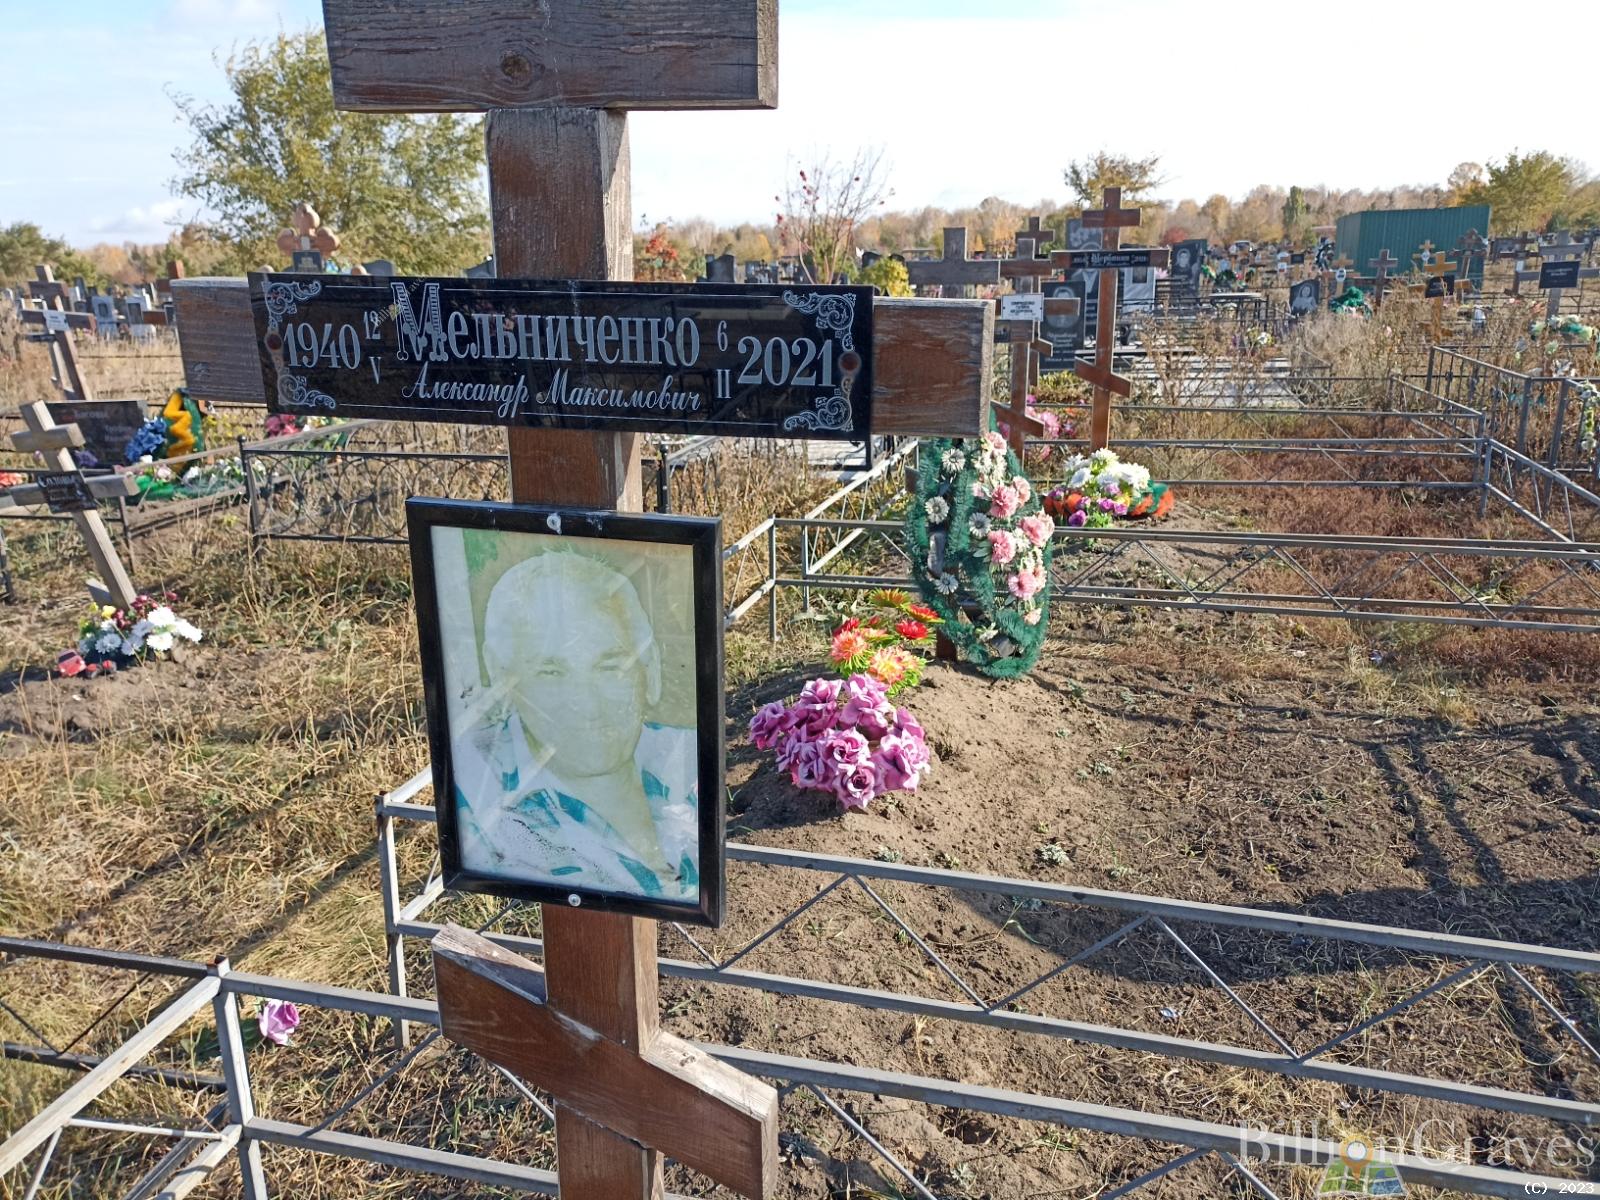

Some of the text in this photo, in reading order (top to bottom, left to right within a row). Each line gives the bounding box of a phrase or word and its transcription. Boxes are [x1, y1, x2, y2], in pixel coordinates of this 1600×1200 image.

[364, 310, 381, 340] 12
[391, 282, 700, 367] Мельниченко
[717, 320, 728, 352] 6
[284, 323, 361, 369] 1940
[737, 336, 836, 386] 2021
[368, 356, 382, 385] V
[401, 361, 701, 418] Александр Максимович
[716, 369, 732, 398] II
